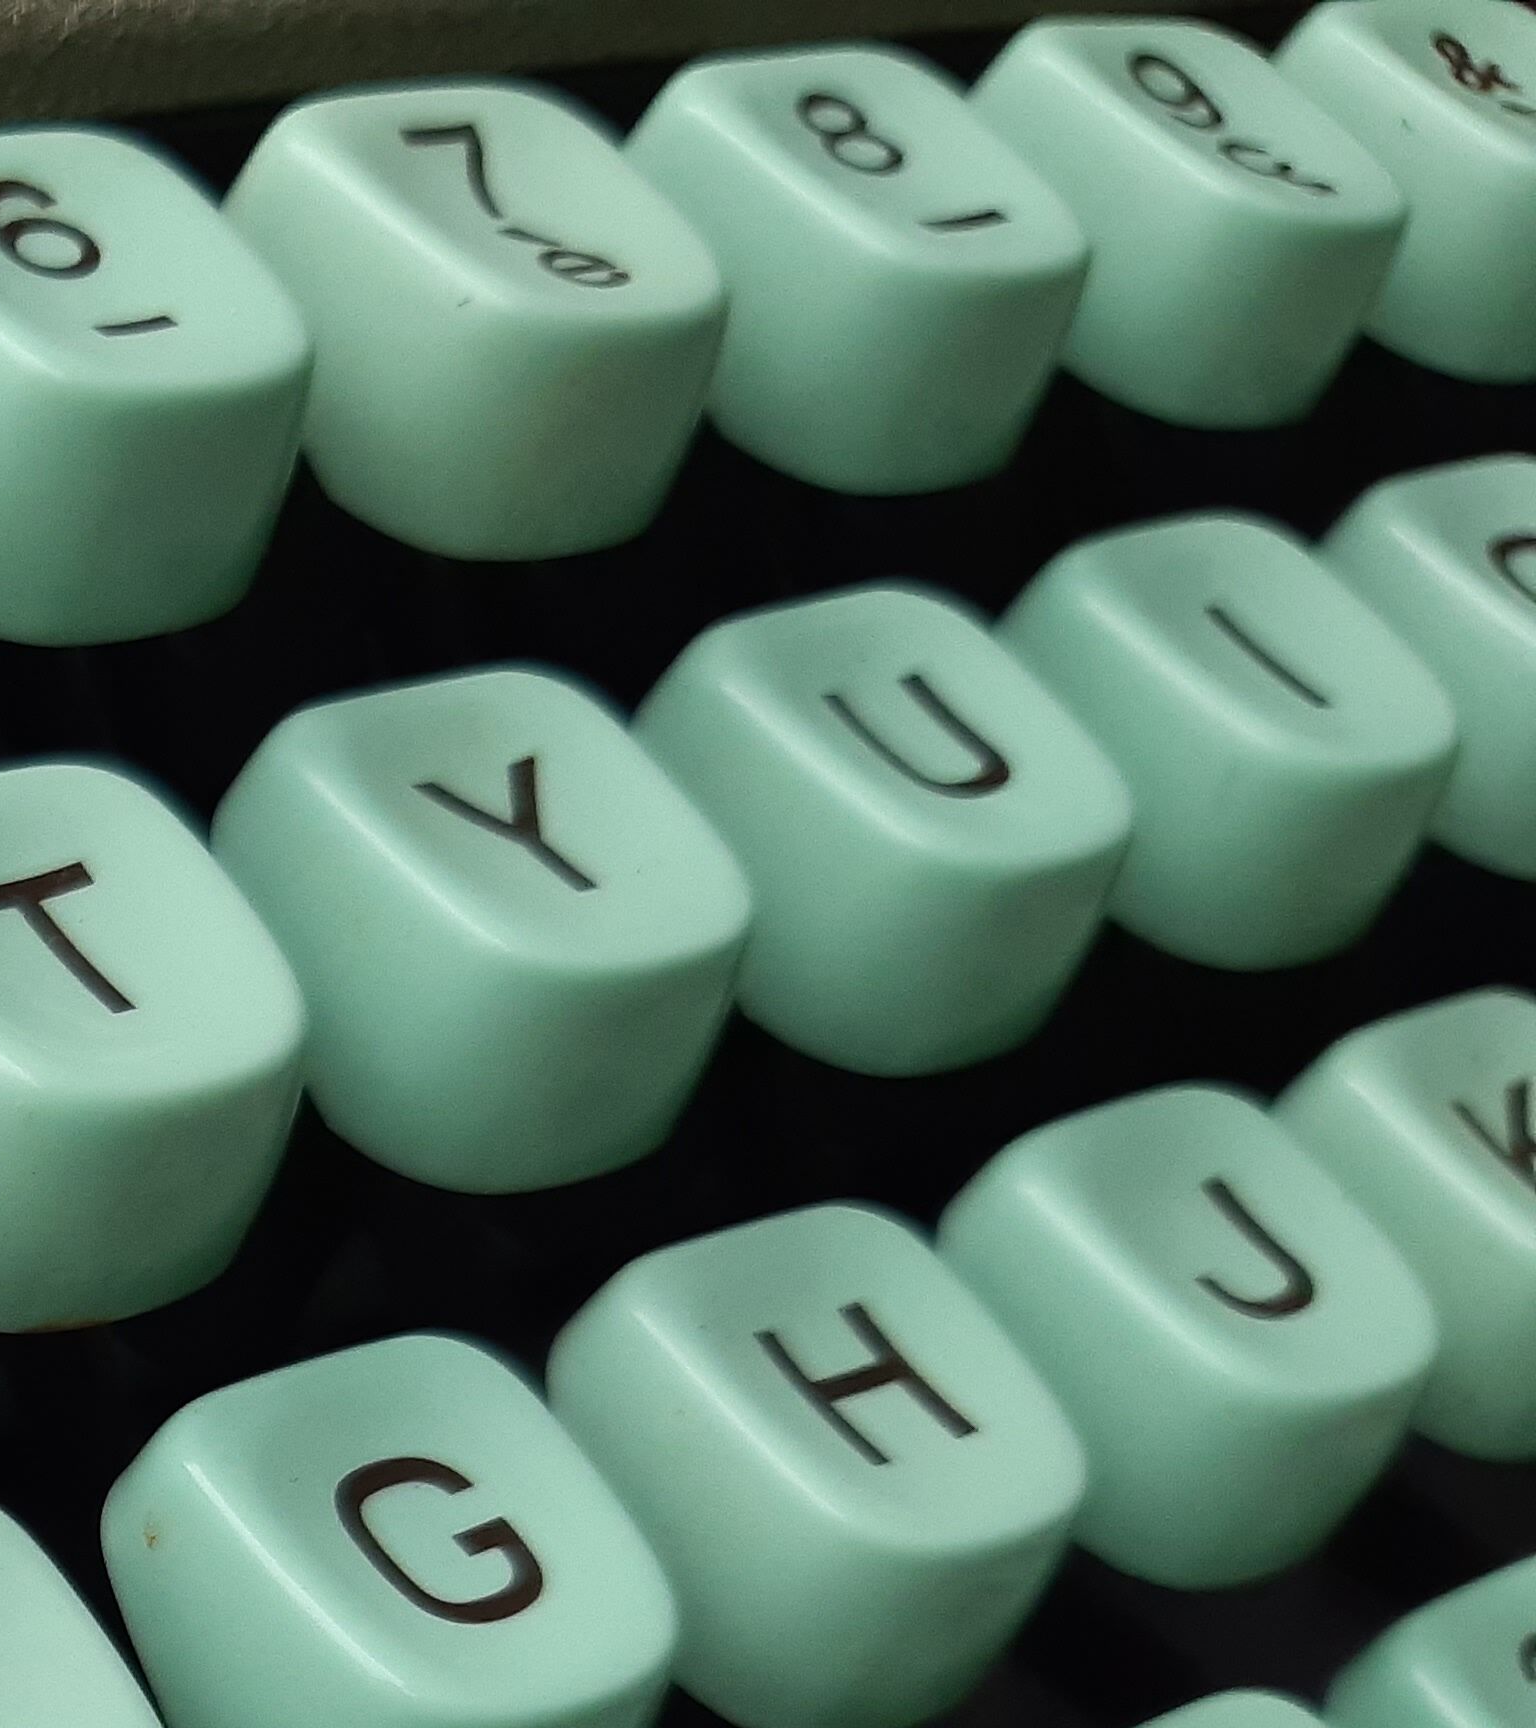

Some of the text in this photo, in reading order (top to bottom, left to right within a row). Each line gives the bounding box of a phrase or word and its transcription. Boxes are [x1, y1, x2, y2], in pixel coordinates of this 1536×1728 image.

[794, 91, 906, 175] 8
[1127, 49, 1224, 130] 9
[401, 123, 499, 216] 7
[822, 673, 1011, 798] U
[413, 756, 596, 890] Y
[1198, 1178, 1315, 1319] J
[754, 1302, 977, 1465] H
[335, 1457, 543, 1624] G
